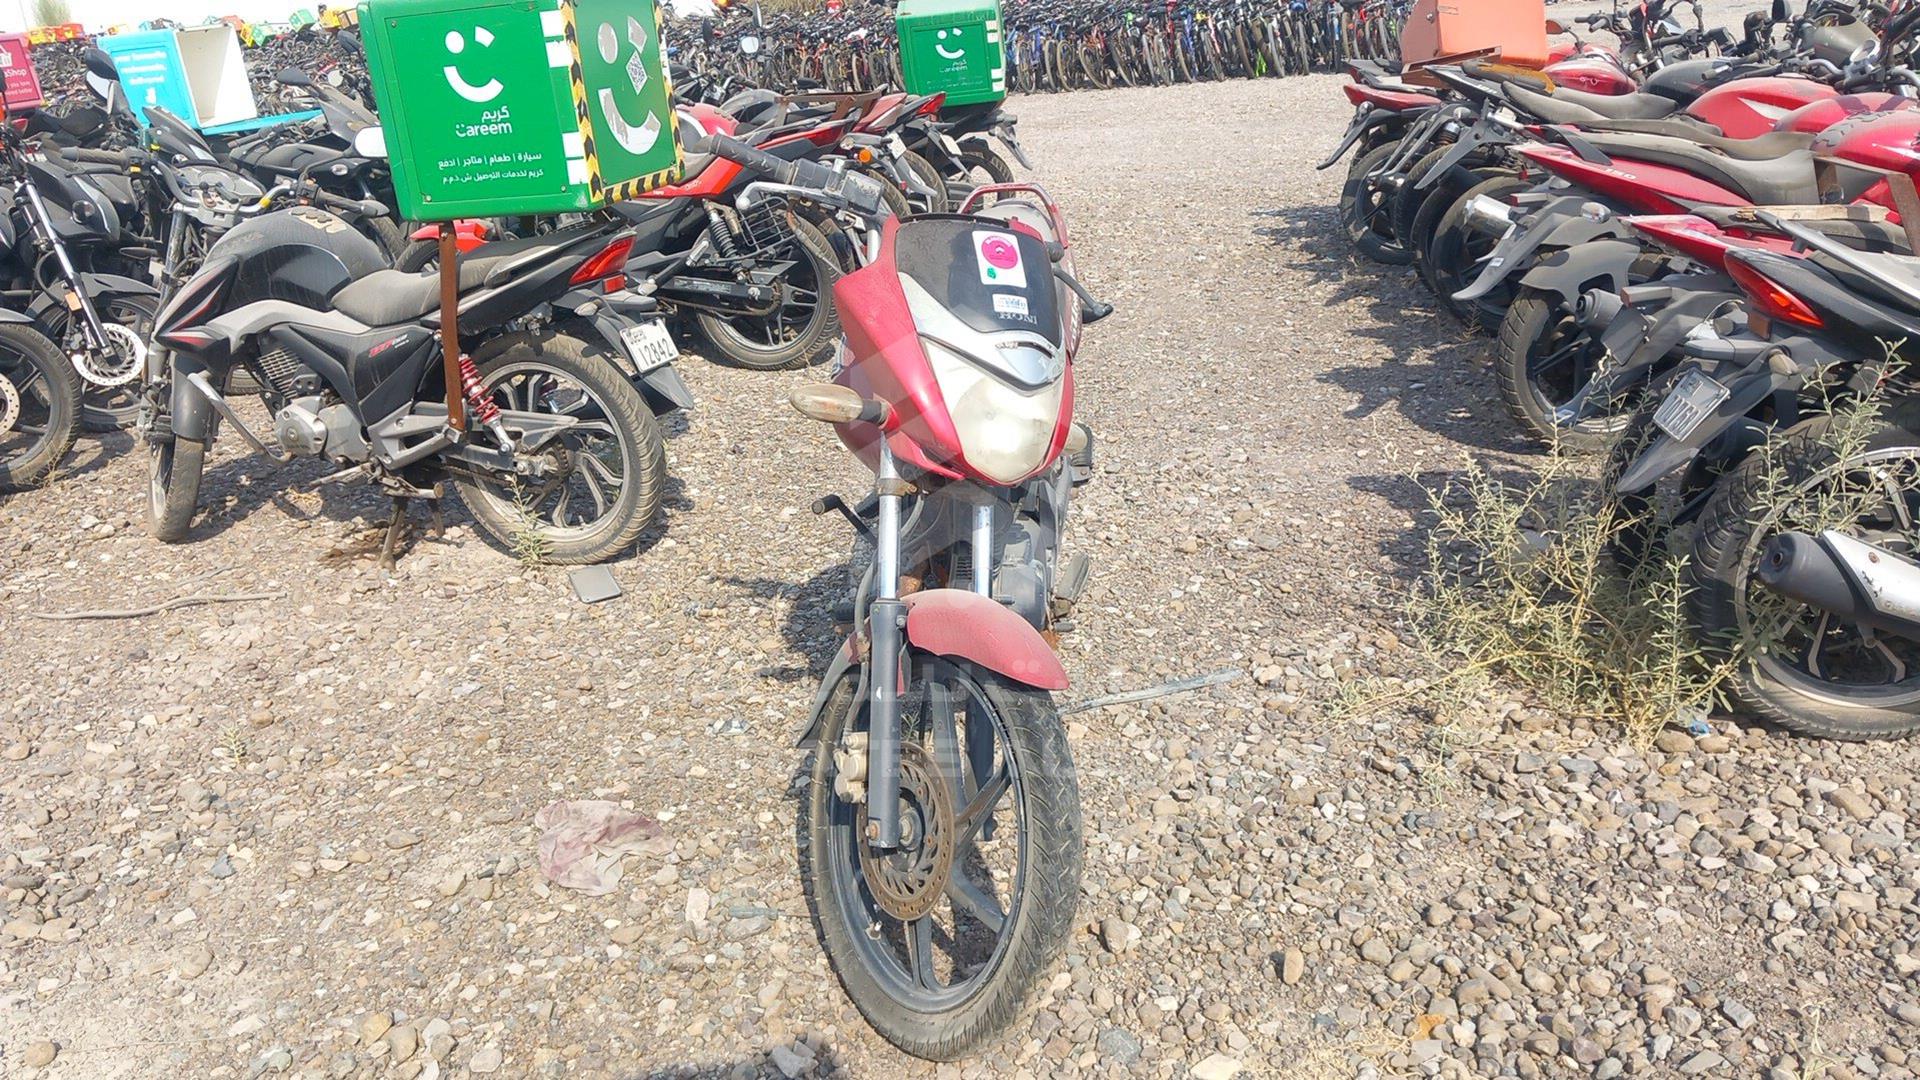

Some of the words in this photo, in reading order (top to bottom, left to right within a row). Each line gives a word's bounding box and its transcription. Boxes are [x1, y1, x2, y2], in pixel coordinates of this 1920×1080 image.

[482, 105, 510, 122] كريم
[455, 122, 512, 137] Careem
[463, 155, 483, 168] متاجر
[489, 153, 511, 166] طعام
[517, 152, 542, 162] سيارة
[437, 158, 456, 170] ادفع
[473, 170, 501, 182] التوصيل
[501, 169, 528, 178] لخدمات
[528, 168, 544, 179] كريم
[638, 338, 674, 367] 12842
